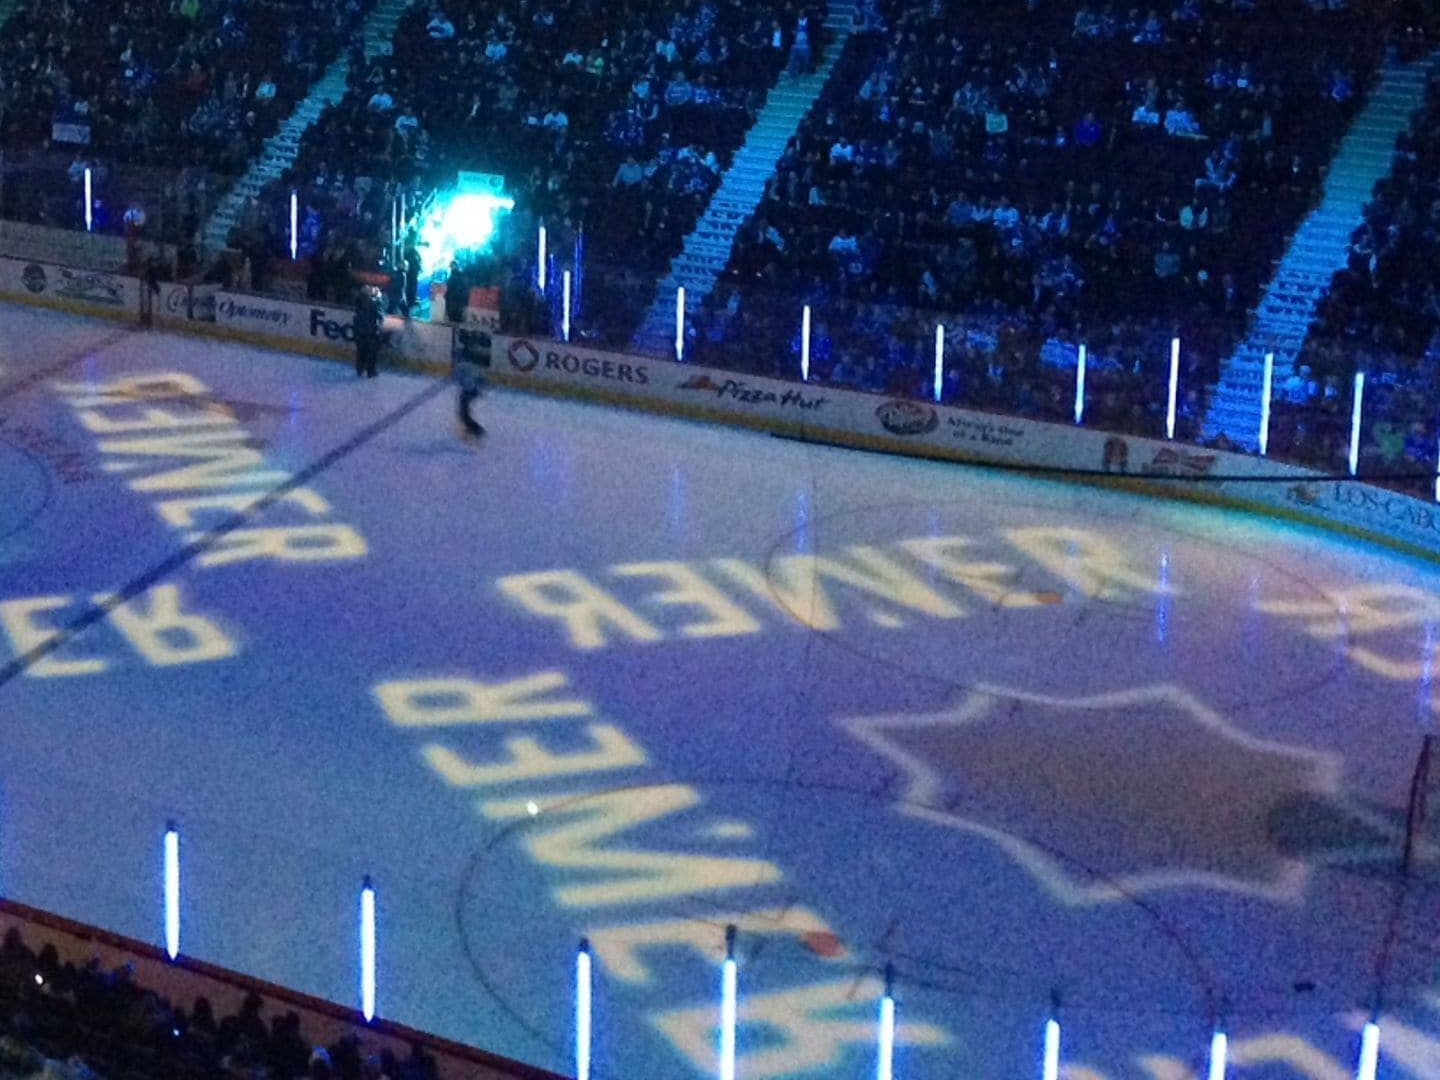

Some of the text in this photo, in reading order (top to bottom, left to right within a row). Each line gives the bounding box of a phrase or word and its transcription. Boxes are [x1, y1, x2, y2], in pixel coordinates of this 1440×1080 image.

[544, 350, 650, 386] ROGERS
[716, 378, 833, 411] Pizza Hut
[1335, 483, 1379, 512] LOS
